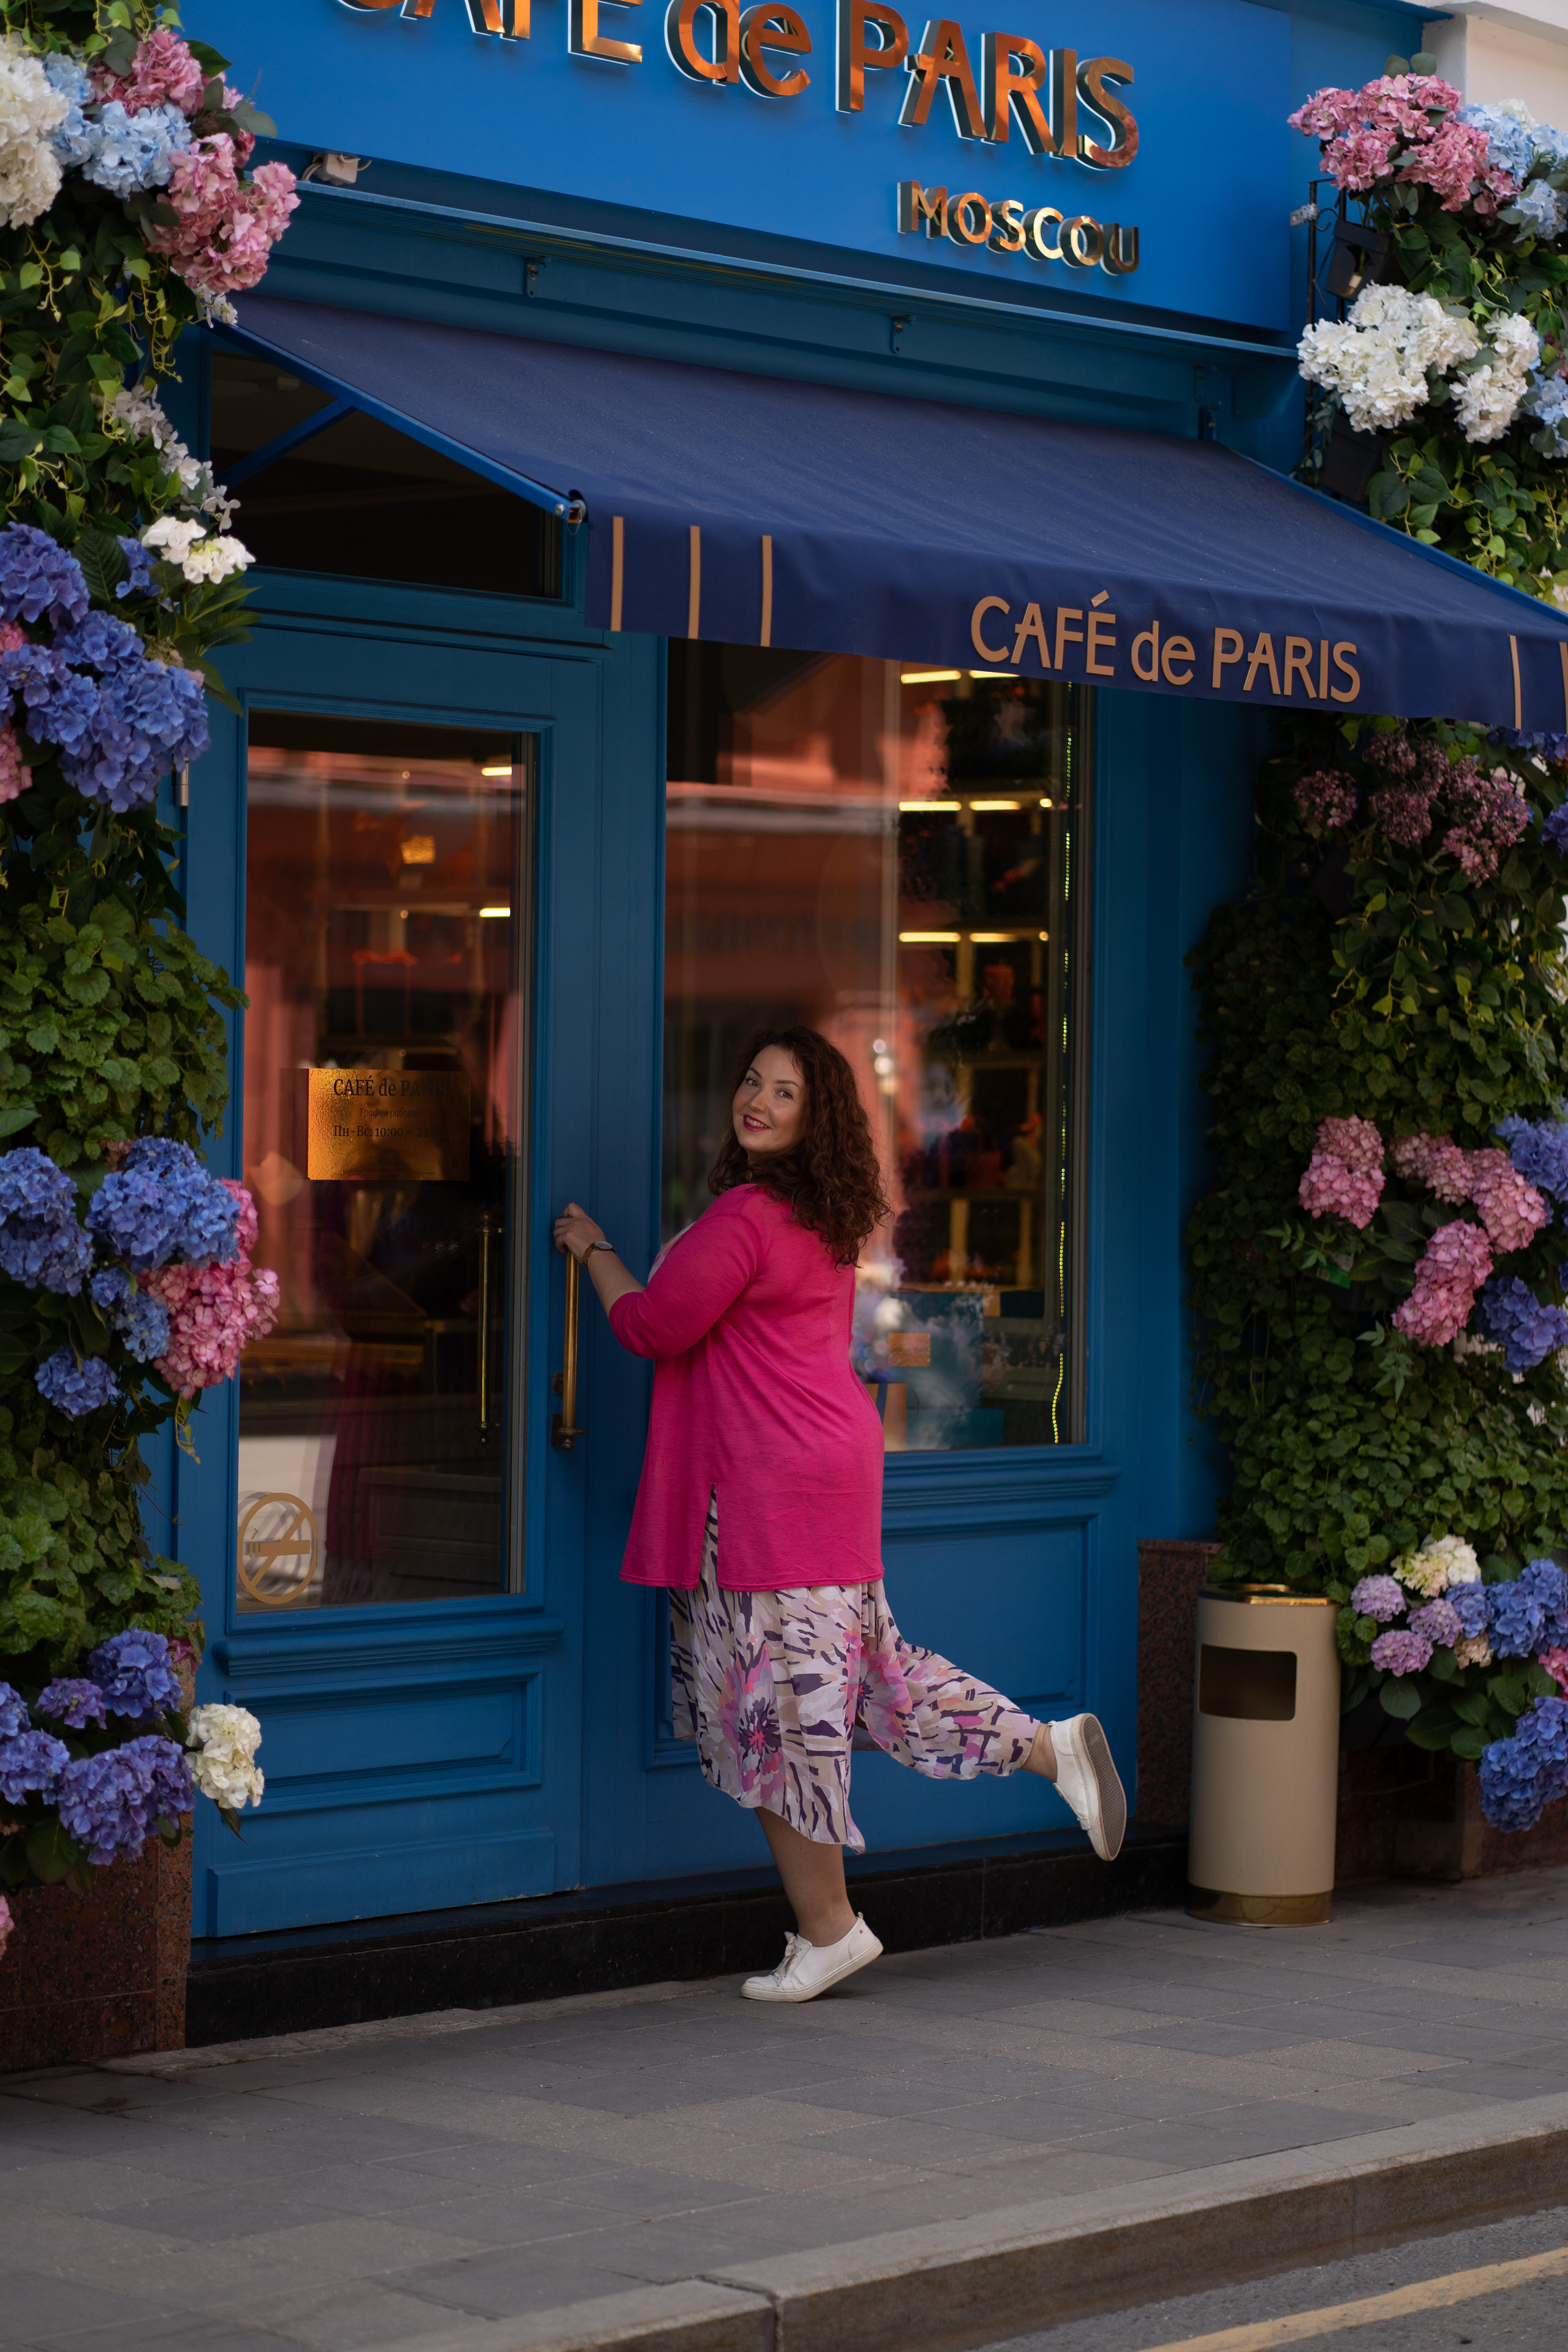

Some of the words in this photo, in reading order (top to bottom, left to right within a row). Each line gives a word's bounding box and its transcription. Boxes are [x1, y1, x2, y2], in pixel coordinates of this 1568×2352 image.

[835, 0, 1139, 170] PARIS
[897, 180, 1140, 276] MOSCOU
[970, 589, 1117, 677] CAFÉ
[1131, 620, 1196, 686] de
[1212, 627, 1361, 703] PARIS
[333, 1075, 375, 1097] CAFÉ
[378, 1078, 397, 1097] de
[400, 1079, 447, 1098] PARIS
[360, 1107, 388, 1120] График
[375, 1127, 404, 1138] 10:00
